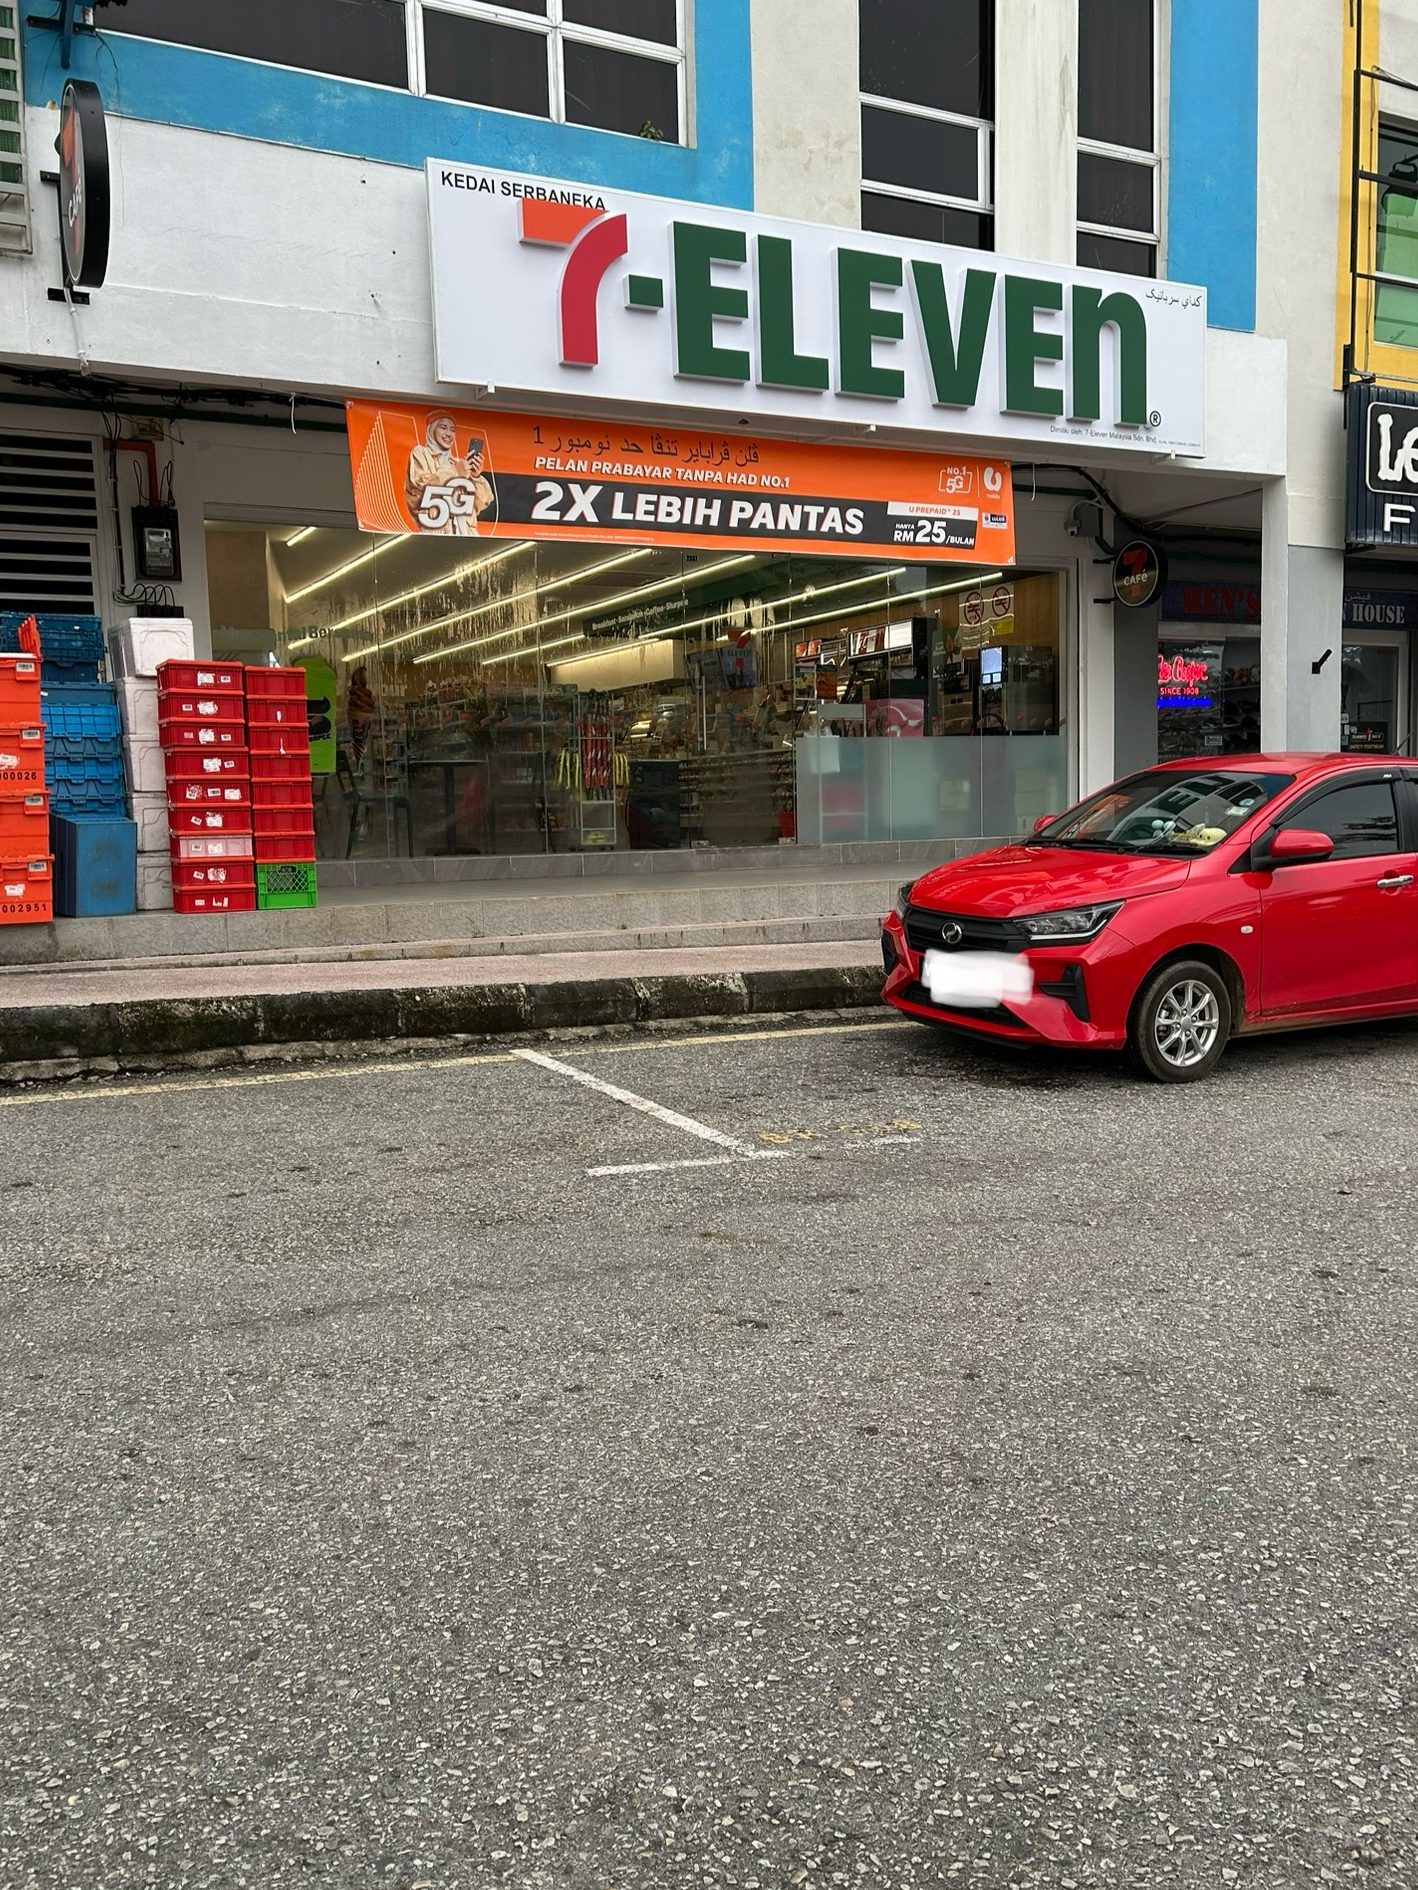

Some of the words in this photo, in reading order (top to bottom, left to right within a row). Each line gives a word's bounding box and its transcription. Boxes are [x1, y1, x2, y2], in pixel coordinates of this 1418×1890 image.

[441, 170, 495, 194] KEDAI
[500, 181, 606, 210] SERBANEKA
[534, 456, 588, 473] PELAN
[591, 461, 672, 480] PRABAYAR
[675, 467, 723, 484] TANPA
[726, 472, 756, 486] HAD
[760, 474, 790, 489] NO.1
[945, 476, 963, 494] 5G
[946, 466, 967, 475] NO.1
[418, 477, 475, 529] 5G
[531, 480, 603, 523] 2X
[611, 491, 723, 527] LEBIH
[728, 500, 865, 535] PANTAS
[1383, 502, 1417, 532] F
[1352, 602, 1406, 624] HOUSE
[0, 771, 37, 780] 00026
